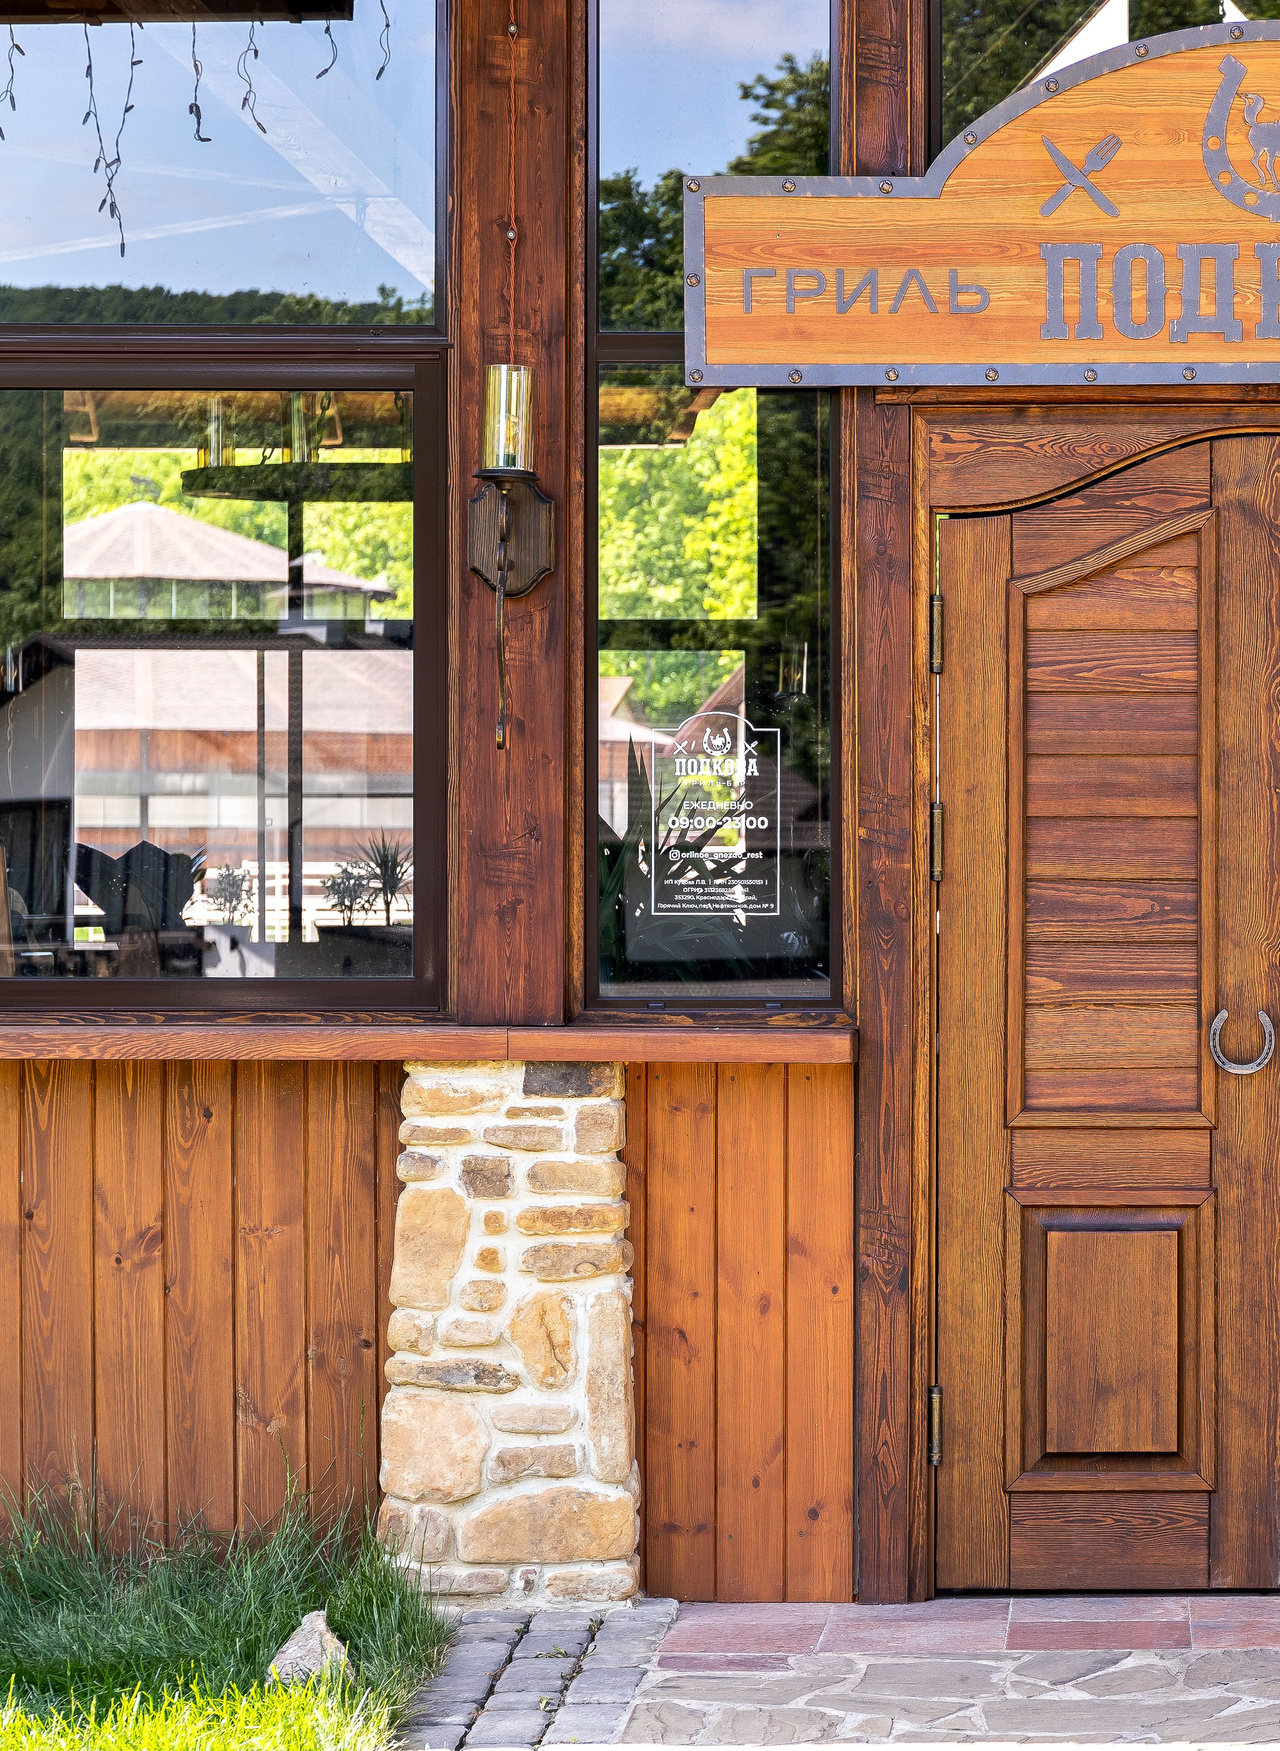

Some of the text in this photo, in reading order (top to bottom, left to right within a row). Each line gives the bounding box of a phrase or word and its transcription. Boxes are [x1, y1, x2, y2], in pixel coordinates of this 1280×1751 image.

[743, 268, 990, 315] ГРИЛЬ
[683, 801, 754, 811] ЕЖЕДНЕВНО
[668, 816, 769, 829] 09:00-2300
